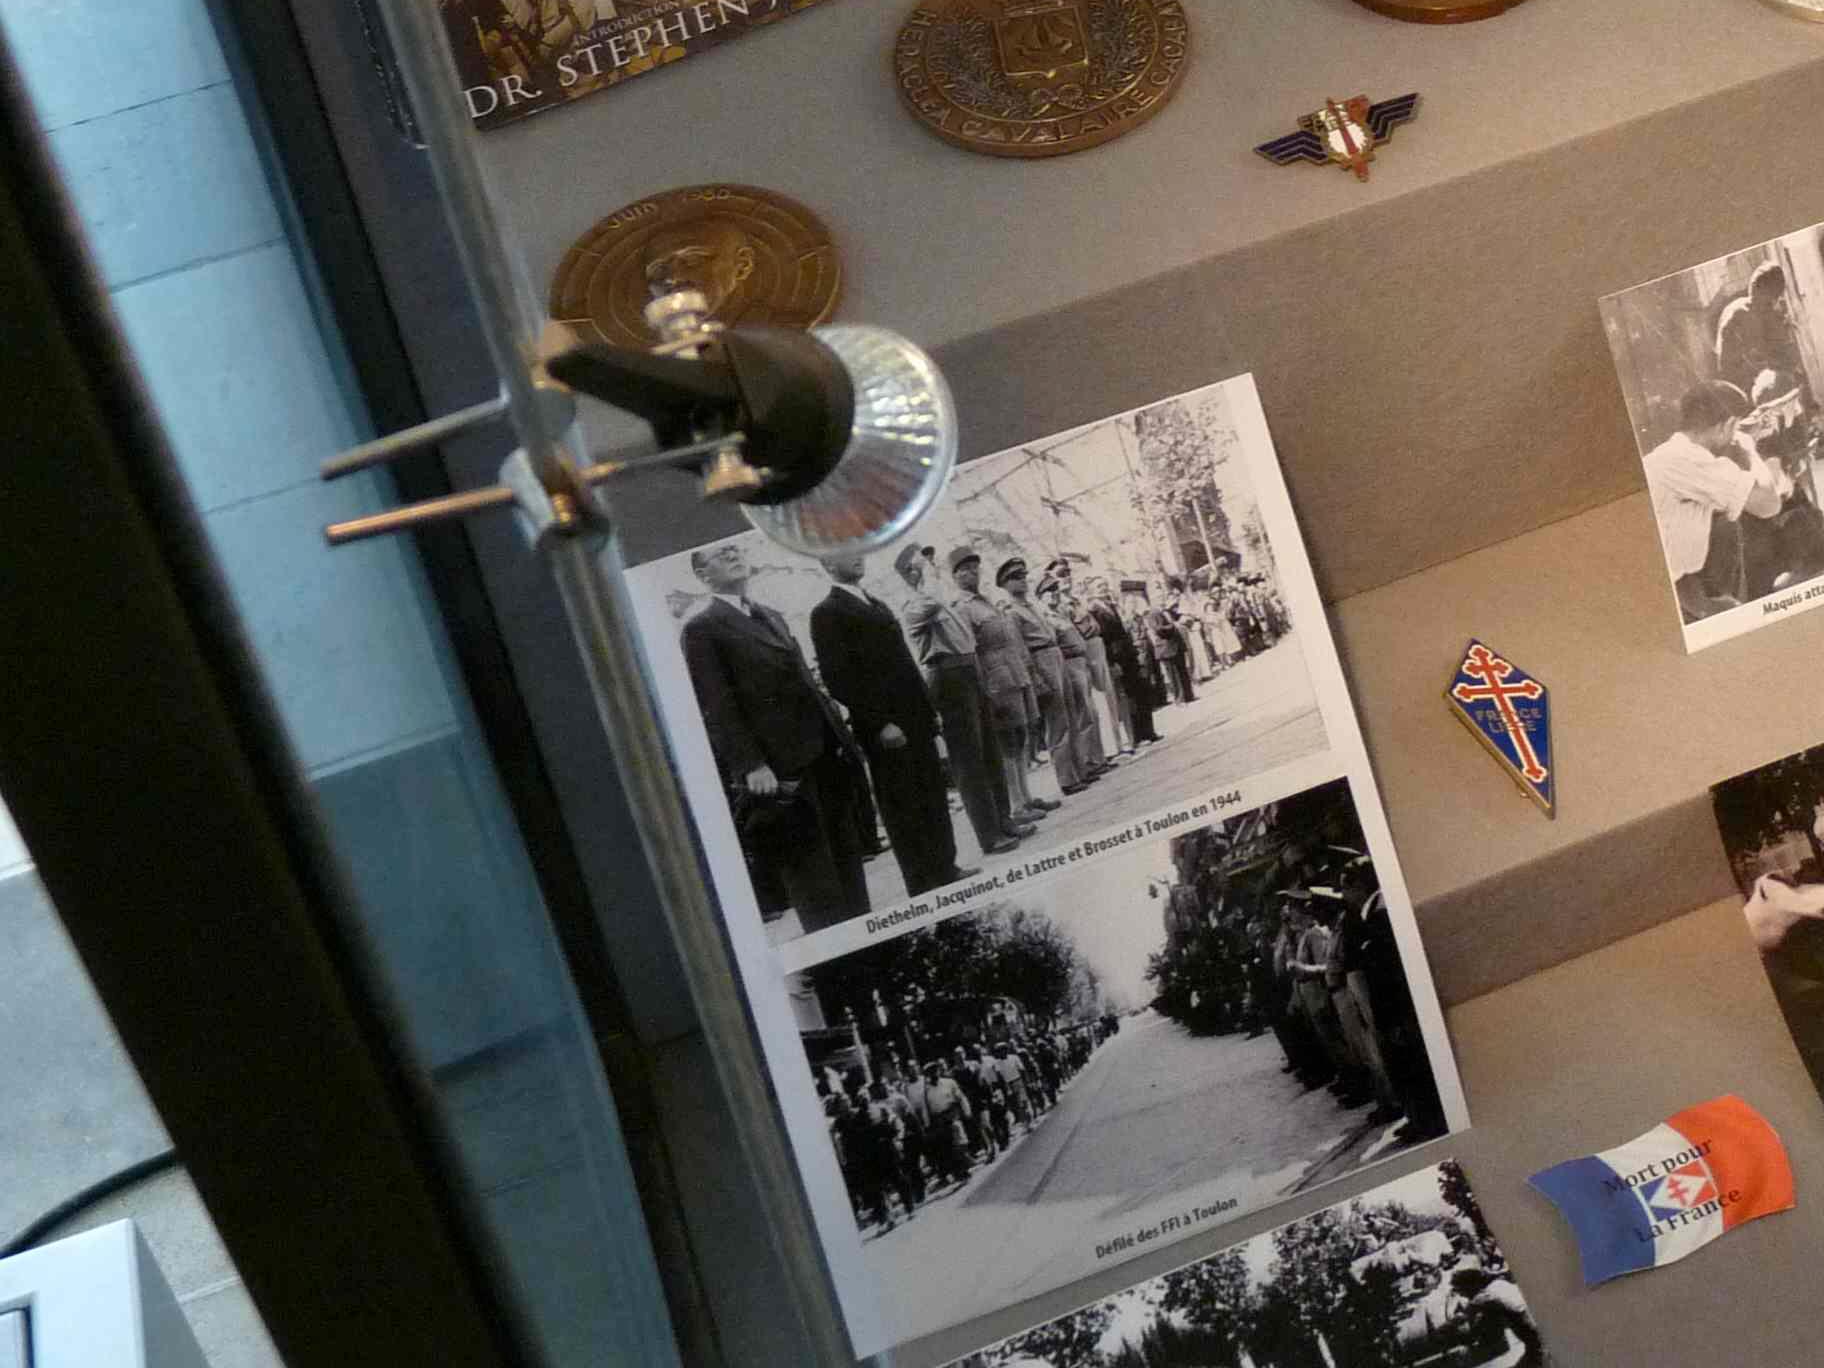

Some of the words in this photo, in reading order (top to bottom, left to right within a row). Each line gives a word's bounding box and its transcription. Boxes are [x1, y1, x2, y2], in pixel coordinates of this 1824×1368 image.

[463, 73, 544, 119] DR.
[1762, 593, 1803, 616] Maquis
[865, 903, 934, 934] Diethelm,
[935, 874, 1005, 910] Jacquinot,
[1006, 867, 1023, 884] de
[1024, 853, 1066, 879] Lattre
[1068, 846, 1083, 863] et
[1084, 831, 1133, 858] Brosset
[1135, 825, 1144, 838] à
[1144, 810, 1190, 835] Toulon
[1191, 804, 1208, 819] en
[1209, 789, 1242, 812] 1944
[1603, 1161, 1660, 1194] Mort
[1661, 1136, 1714, 1174] pour
[1095, 1233, 1135, 1259] Défilé
[1136, 1226, 1159, 1244] des
[1160, 1216, 1181, 1235] FFI
[1183, 1213, 1192, 1227] à
[1191, 1197, 1239, 1222] Toulon
[1666, 1187, 1743, 1230] France
